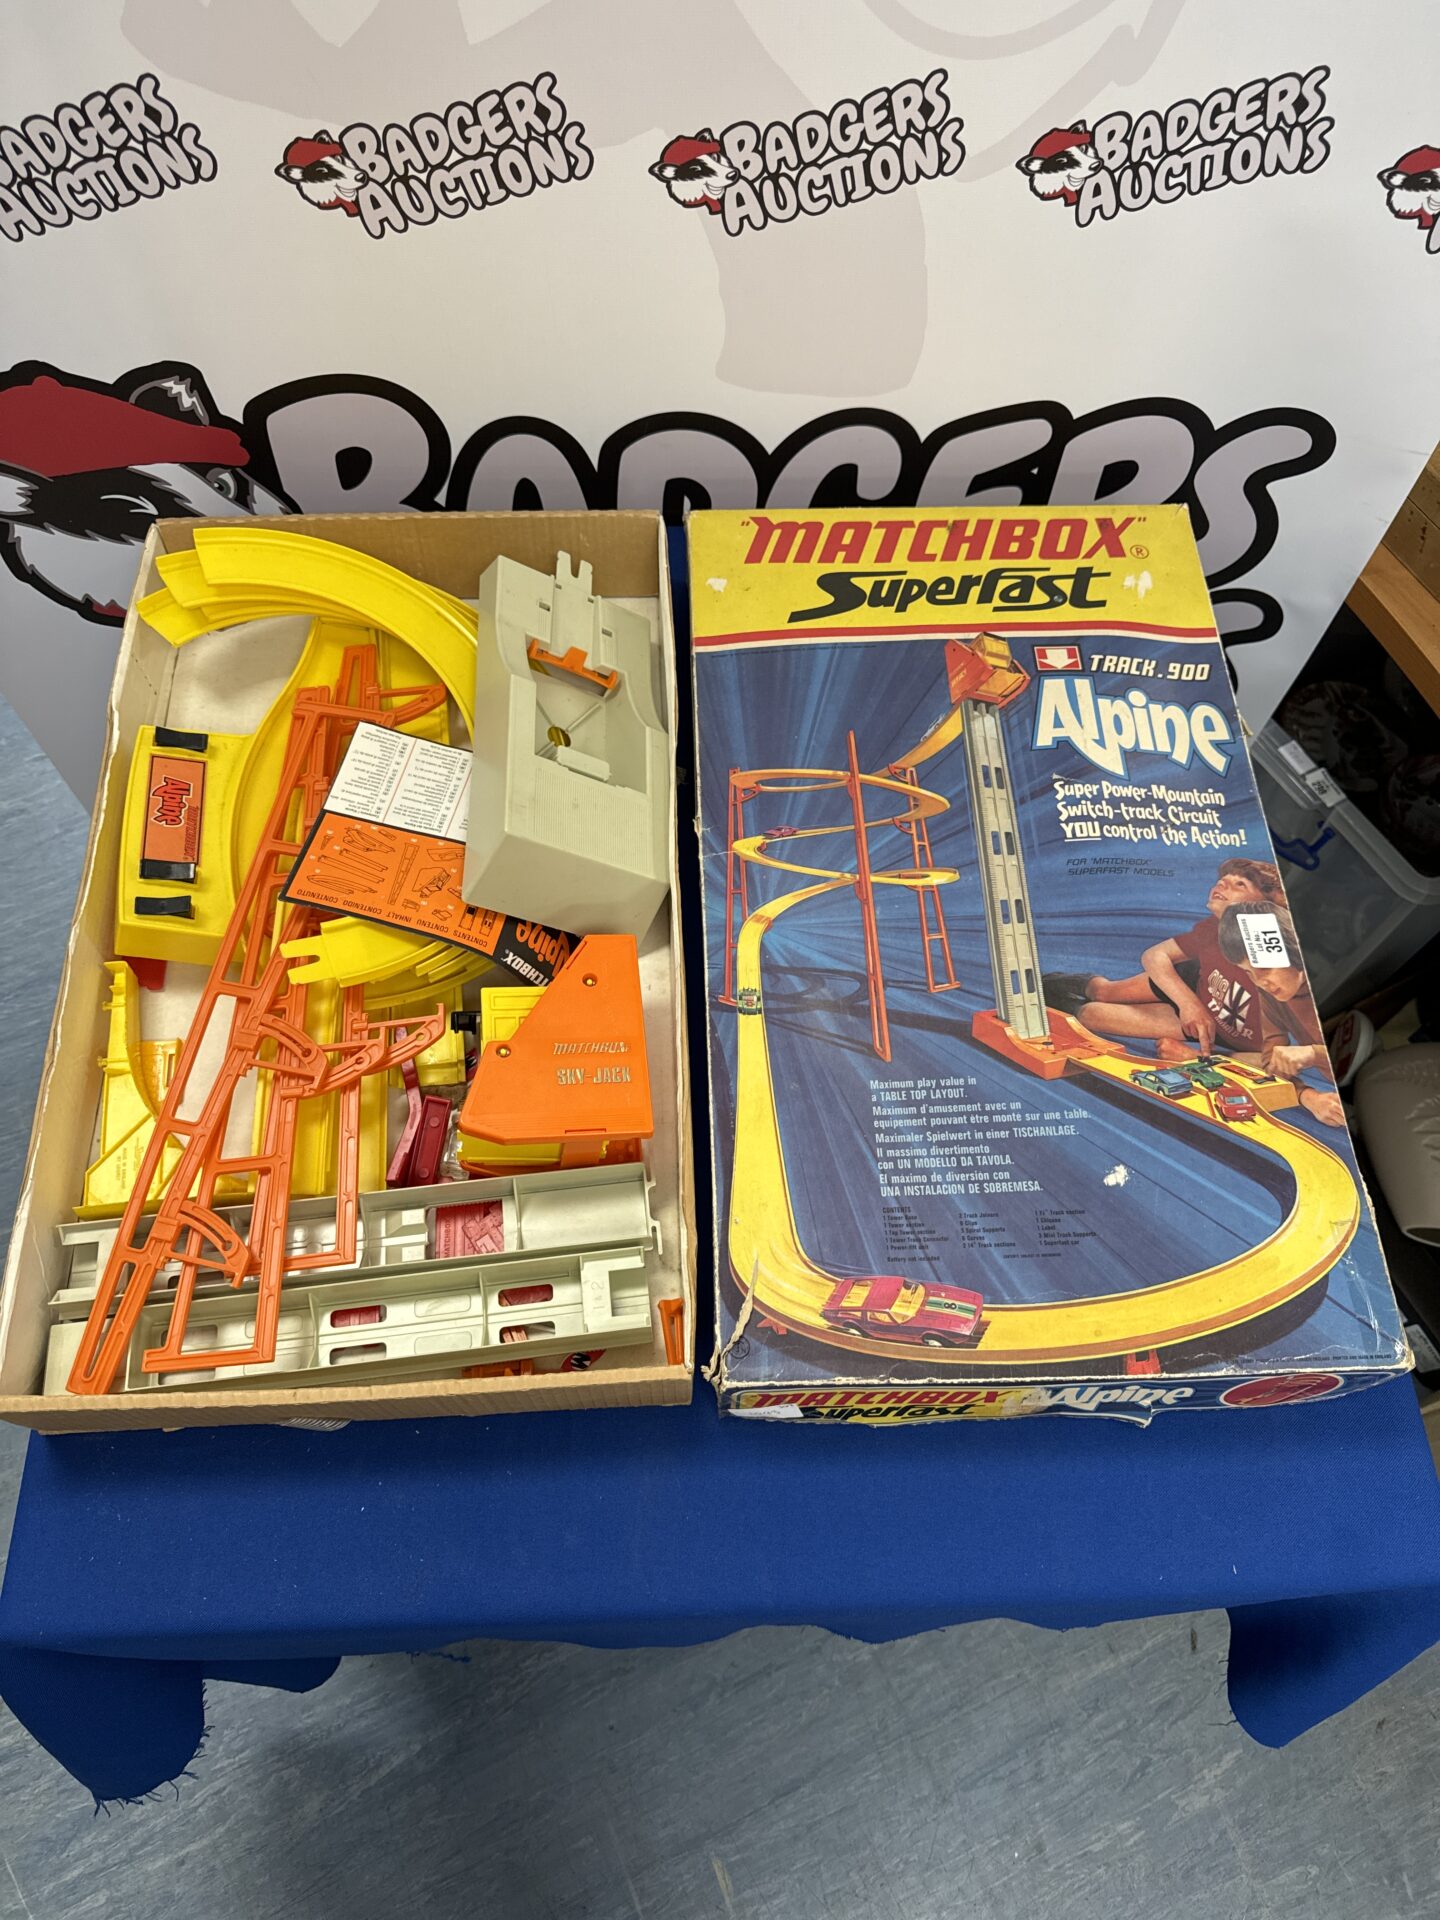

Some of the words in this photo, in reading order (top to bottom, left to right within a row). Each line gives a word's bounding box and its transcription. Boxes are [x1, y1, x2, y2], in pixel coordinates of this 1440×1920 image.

[339, 71, 566, 184] BADGERS
[720, 68, 950, 182] BADGERS
[1093, 65, 1330, 171] BADGERS
[358, 121, 593, 239] AUCTIONS
[722, 117, 966, 237] AUCTIONS
[1075, 116, 1335, 228] AUCTIONS
[786, 566, 1111, 623] Superfast
[1033, 676, 1234, 778] Alpine
[152, 775, 192, 826] Alpine
[1053, 781, 1099, 800] Super
[1102, 780, 1225, 806] Power-Mountain
[1057, 801, 1167, 822] Switch-track
[1168, 806, 1222, 828] Circuit
[1060, 821, 1101, 842] YOU
[1103, 824, 1157, 843] control
[1162, 824, 1187, 846] the
[1191, 828, 1248, 849] Action!
[1066, 858, 1087, 866] FOR
[1068, 867, 1130, 876] SUPERFAST
[1133, 868, 1176, 877] MODELS
[297, 888, 338, 907] CONTENUTO
[342, 899, 383, 915] CONTENIDO
[386, 912, 412, 923] INHALT
[416, 919, 449, 934] CONTENU
[452, 930, 488, 948] CONTENTS
[1261, 930, 1283, 953] 351
[556, 1066, 631, 1085] SKY-JACK
[870, 1079, 914, 1089] Maximum
[917, 1077, 936, 1089] play
[940, 1076, 965, 1086] value
[968, 1075, 976, 1085] in
[872, 1094, 877, 1102] a
[880, 1090, 907, 1101] TABLE
[910, 1089, 927, 1100] TOP
[930, 1088, 968, 1099] LAYOUT.
[873, 1106, 917, 1116] Maximum
[920, 1102, 982, 1113] d'amusement
[985, 1102, 1007, 1111] avec
[1010, 1101, 1021, 1110] un
[930, 1114, 968, 1127] pouvant
[1025, 1112, 1041, 1121] sur
[1044, 1111, 1061, 1120] une
[1064, 1108, 1092, 1119] table.
[875, 1132, 924, 1144] Maximaler
[926, 1130, 972, 1143] Spielwert
[974, 1129, 984, 1140] in
[986, 1128, 1010, 1139] einer
[1013, 1125, 1080, 1138] TISCHANLAGE.
[887, 1146, 928, 1157] massimo
[930, 1144, 990, 1156] divertimento
[877, 1160, 894, 1170] con
[897, 1158, 911, 1169] UN
[914, 1156, 957, 1168] MODELLO
[960, 1155, 974, 1166] DA
[976, 1154, 1015, 1166] TAVOLA.
[879, 1174, 888, 1184] El
[931, 1172, 943, 1183] de
[993, 1171, 1010, 1180] con
[880, 1185, 901, 1197] UNA
[904, 1183, 965, 1196] INSTALACION
[968, 1183, 980, 1194] DE
[983, 1180, 1044, 1193] SOBREMESA.
[1049, 1386, 1196, 1411] Alpine
